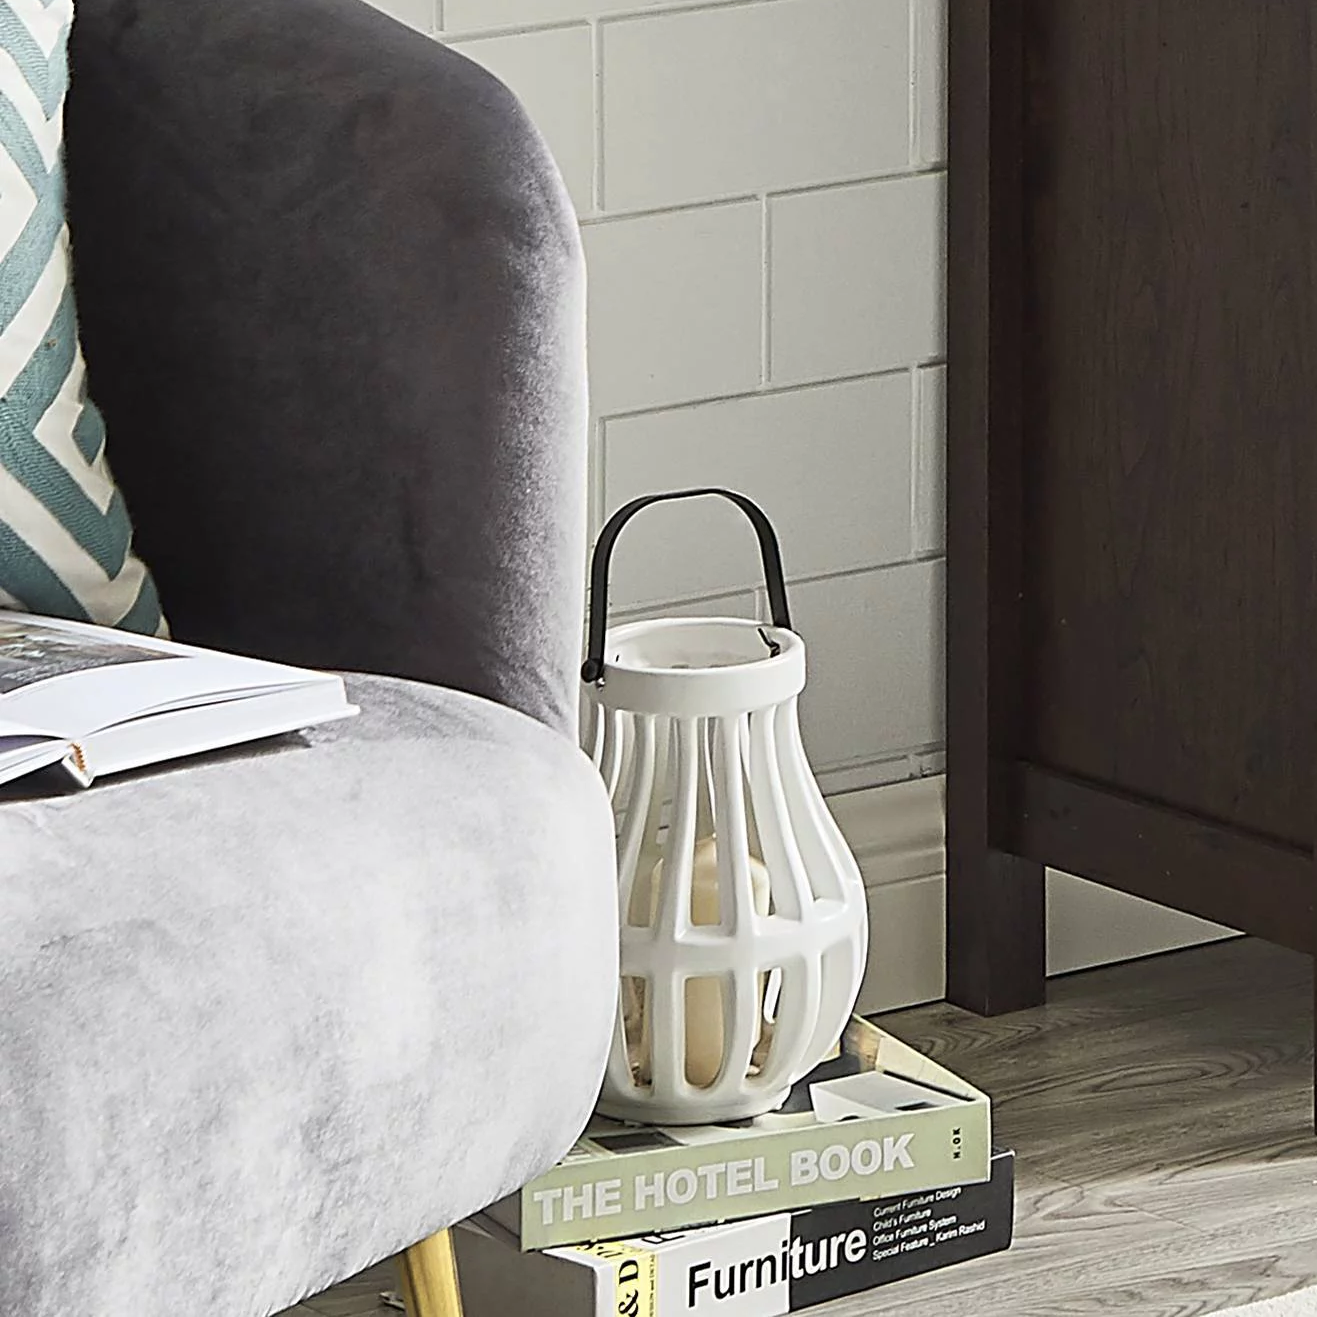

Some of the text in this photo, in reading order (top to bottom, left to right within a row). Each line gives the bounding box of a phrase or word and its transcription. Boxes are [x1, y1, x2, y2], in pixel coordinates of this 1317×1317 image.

[532, 1133, 915, 1226] THE HOTEL BOOK
[873, 1186, 962, 1218] Current Furniture Design
[872, 1216, 957, 1246] Office Furniture System
[899, 1209, 932, 1226] Furniture
[872, 1245, 900, 1262] Special
[900, 1237, 929, 1253] Feature
[618, 1259, 639, 1286] D
[685, 1225, 869, 1310] Furniture
